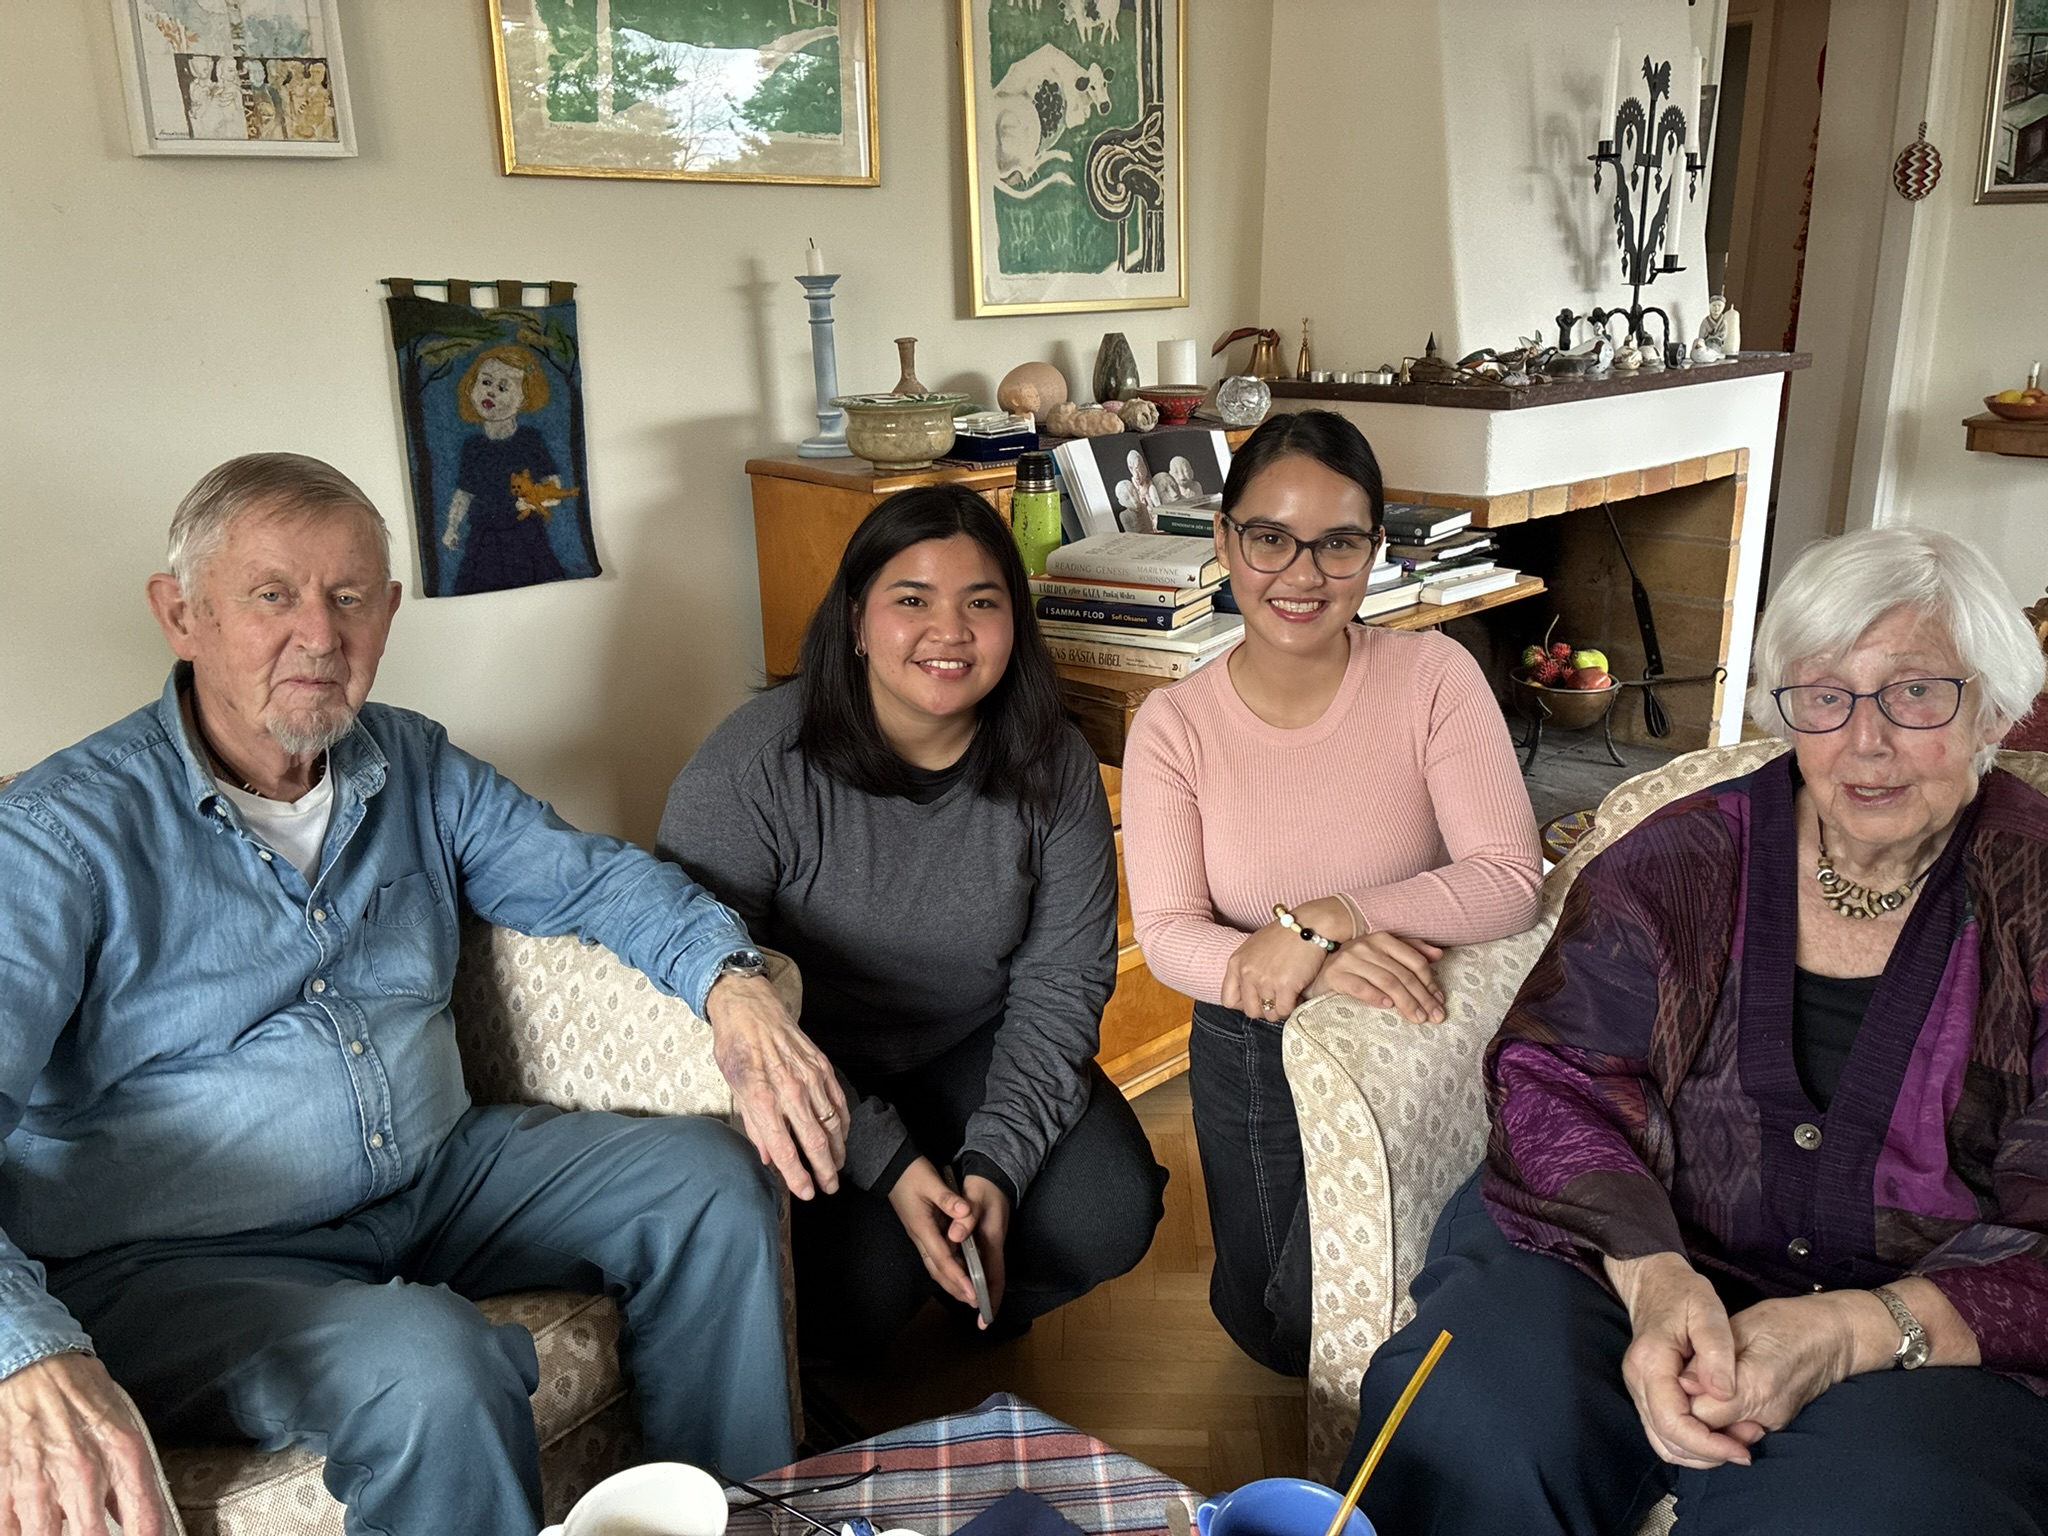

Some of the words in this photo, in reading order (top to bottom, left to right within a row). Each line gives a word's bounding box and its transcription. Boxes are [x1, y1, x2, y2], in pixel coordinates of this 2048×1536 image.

[1055, 561, 1091, 573] READING
[1095, 566, 1129, 576] GENESIS
[1137, 565, 1179, 576] MARILYNNE
[1139, 575, 1176, 584] ROBINSON
[1068, 587, 1081, 596] efter
[1082, 587, 1100, 599] GAZA
[1045, 607, 1049, 615] I
[1050, 608, 1081, 618] SAMMA
[1082, 610, 1105, 620] FLOD
[1111, 613, 1123, 621] Sofi
[1123, 614, 1148, 623] Oksanen
[1068, 648, 1096, 665] BÄSTA
[1098, 652, 1122, 667] BIBEL
